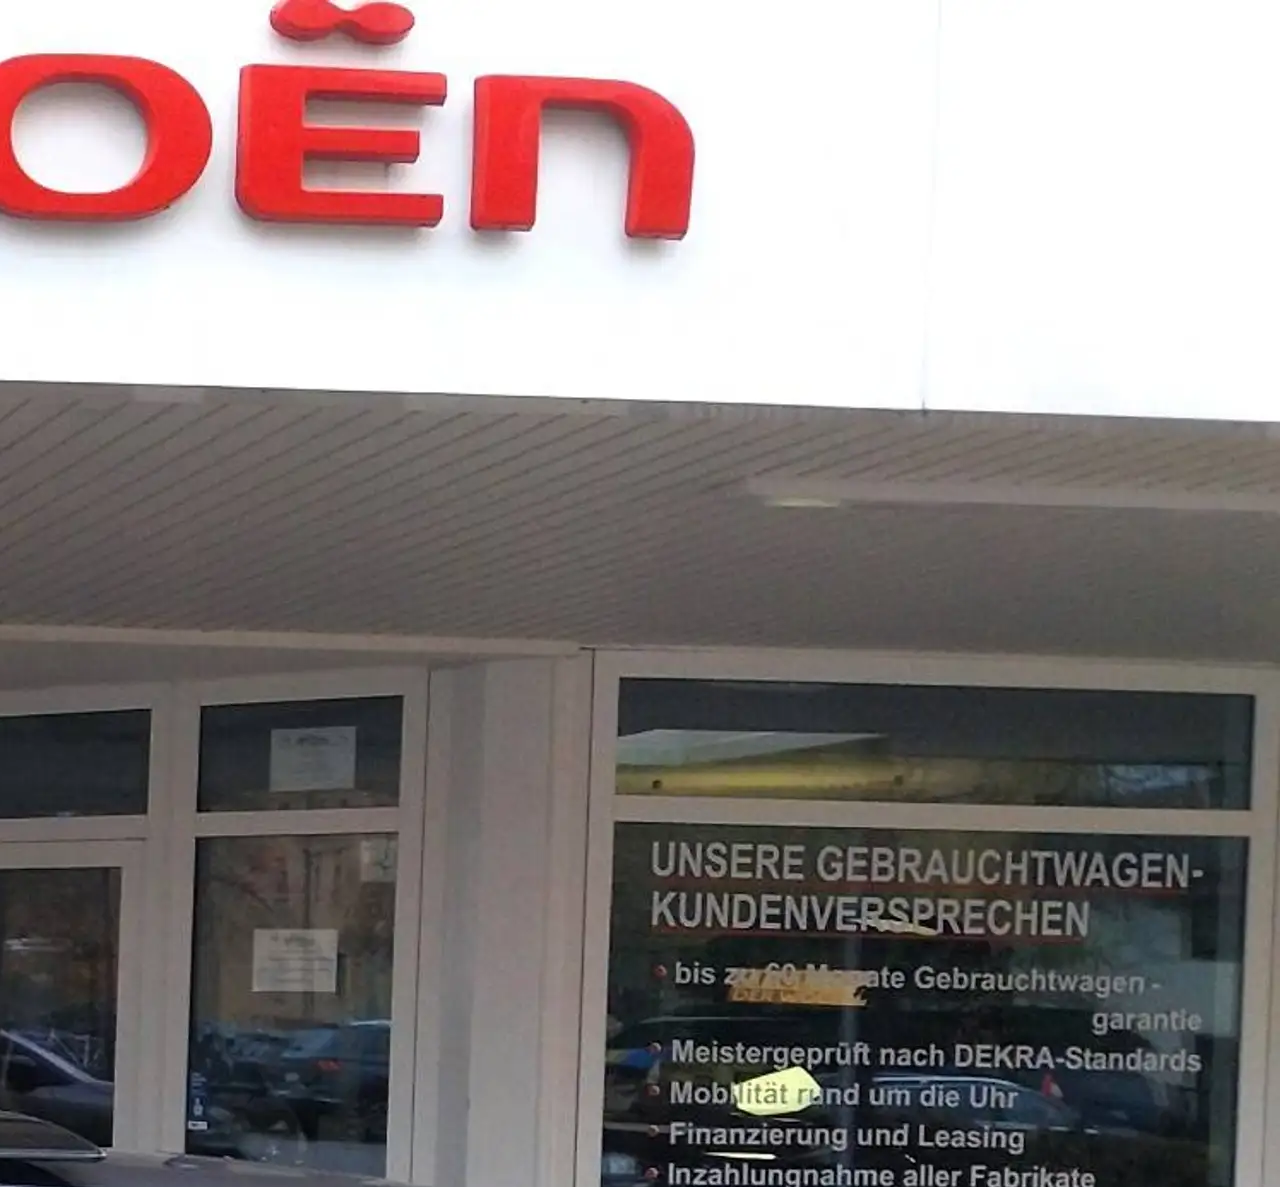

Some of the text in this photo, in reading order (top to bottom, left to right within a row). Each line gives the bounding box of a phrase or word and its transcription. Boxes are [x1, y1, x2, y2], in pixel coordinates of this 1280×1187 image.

[651, 841, 1204, 888] UNSERE GEBRAUCHTWAGEN-
[651, 890, 1090, 937] KUNDENVERSPRECHEN
[674, 961, 716, 985] bis
[913, 965, 1145, 998] Gebrauchtwagen
[1092, 1007, 1203, 1035] garantie
[671, 1039, 1203, 1072] Meistergeprüft nach DEKRA-Standards
[670, 1081, 1019, 1109] Mobilität rund um die Uhr
[669, 1121, 1026, 1155] Finanzierung und Leasing
[903, 1164, 963, 1187] aller
